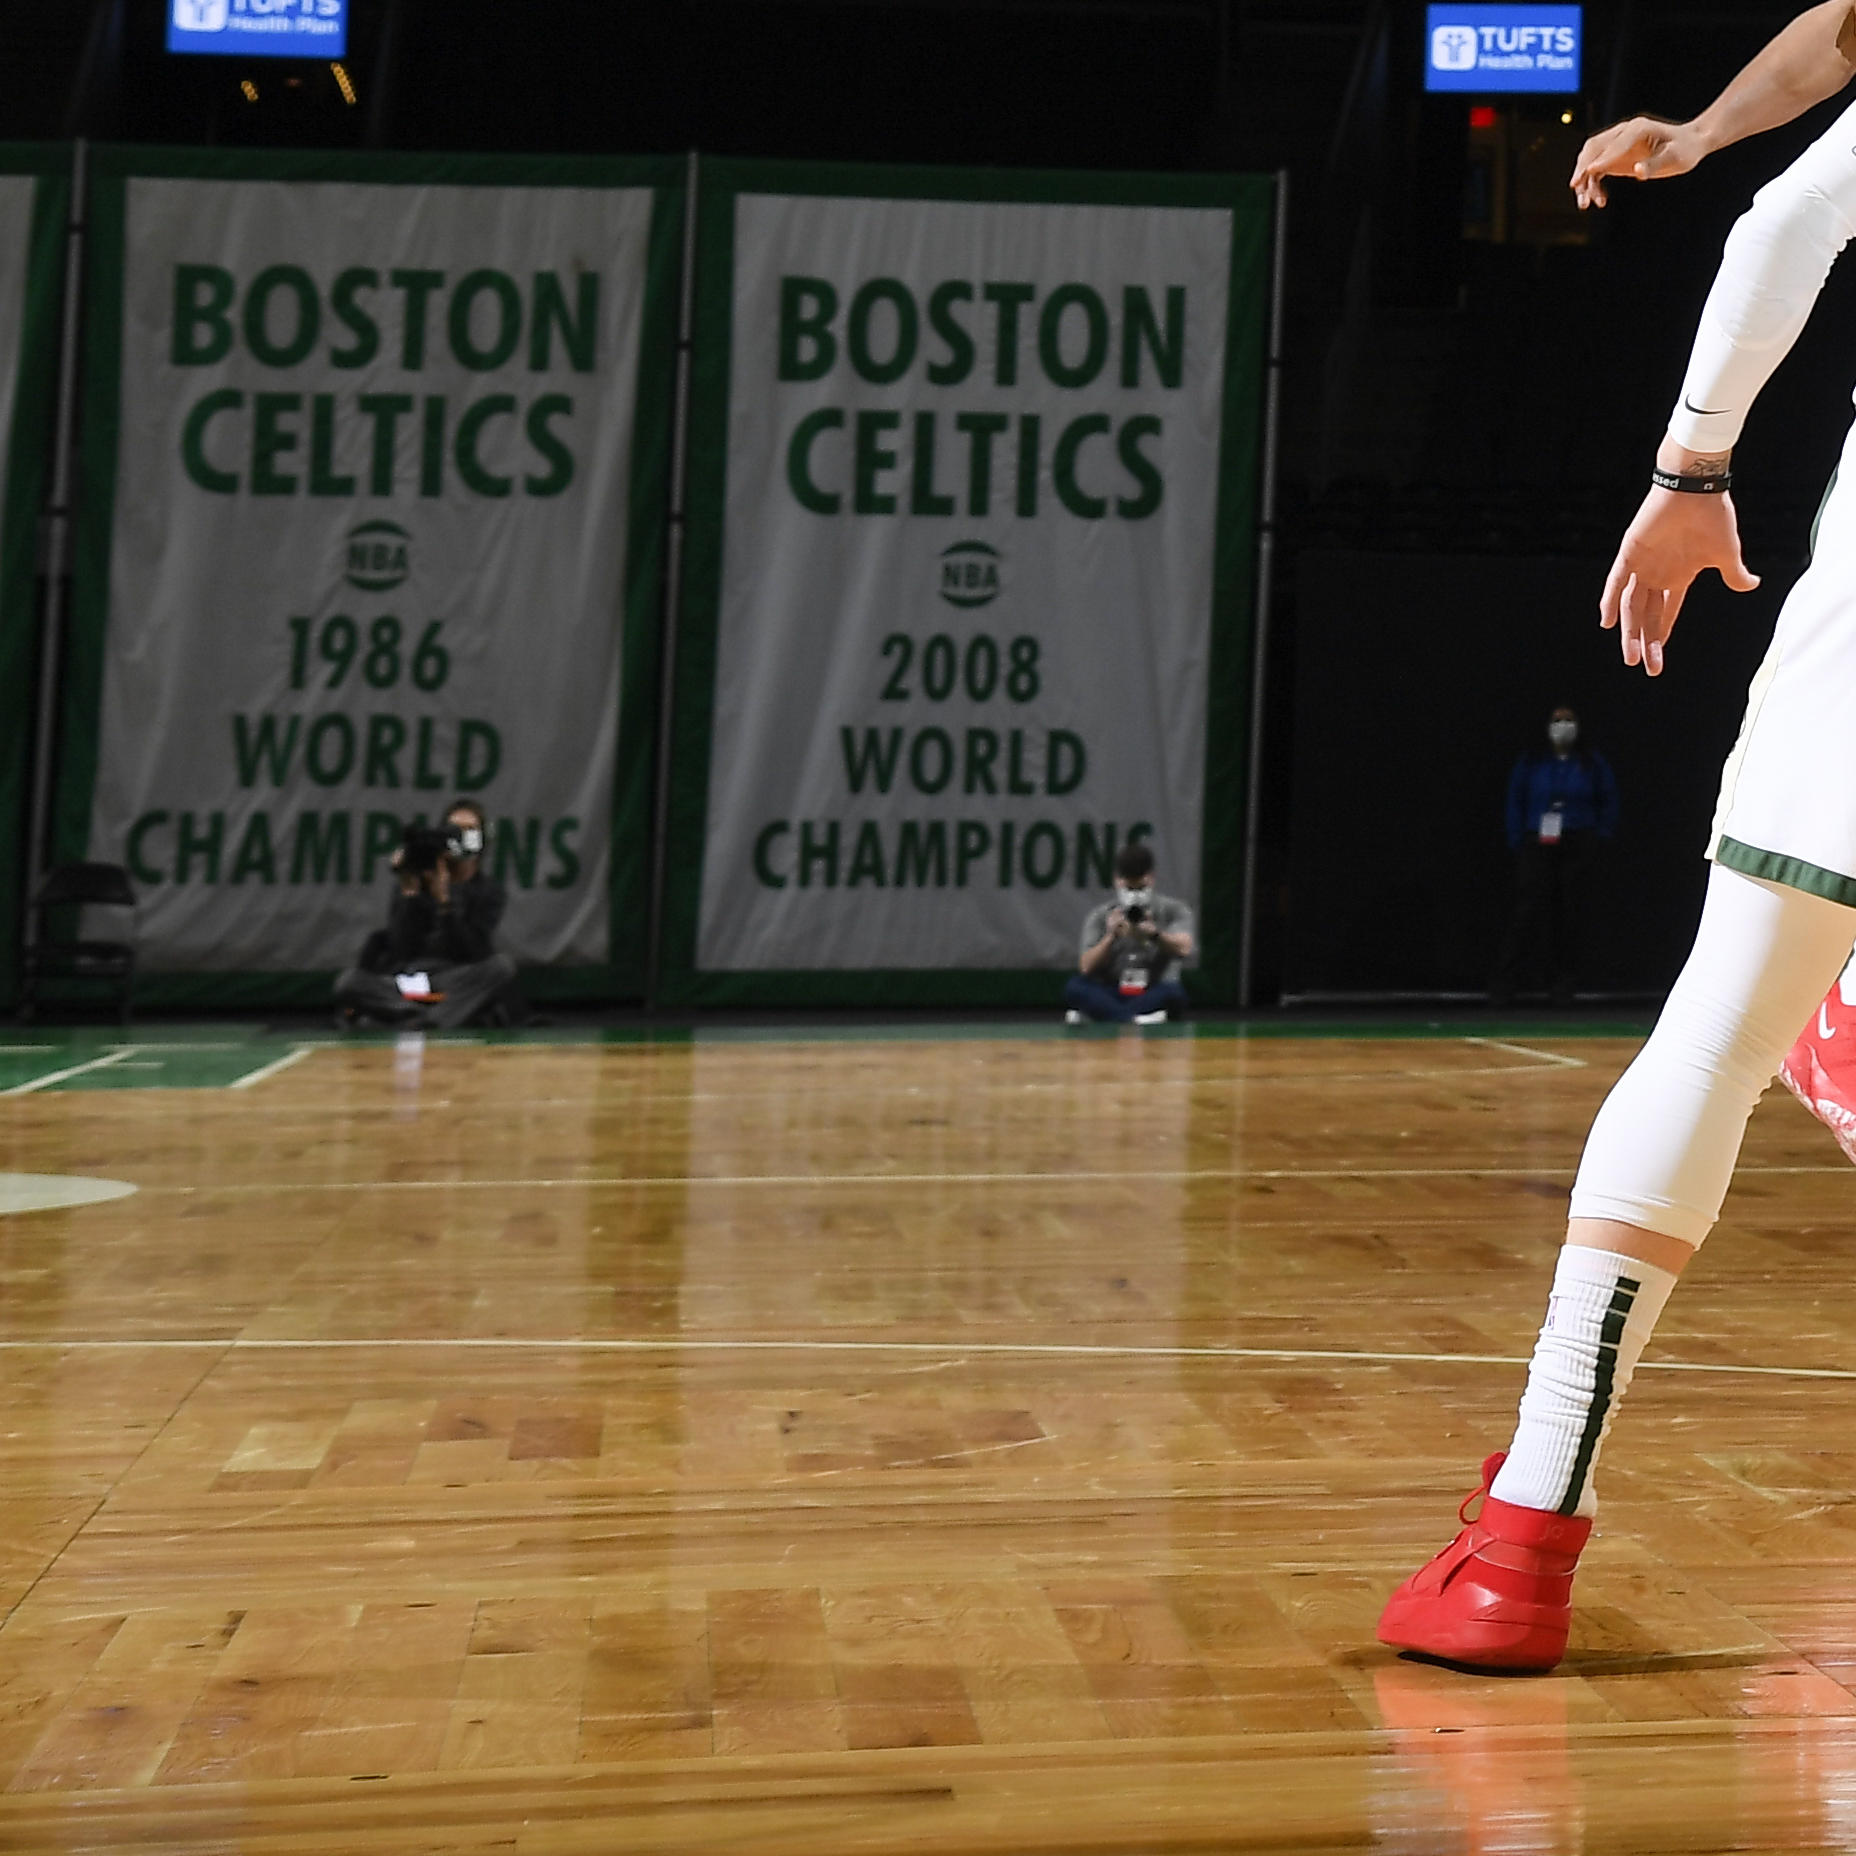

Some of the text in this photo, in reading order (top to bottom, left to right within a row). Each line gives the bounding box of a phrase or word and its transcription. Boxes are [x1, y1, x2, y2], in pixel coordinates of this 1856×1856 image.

[1478, 25, 1575, 53] TUFTS
[170, 263, 601, 373] BOSTON
[778, 276, 1186, 389] BOSTON
[182, 388, 577, 498] CELTICS
[786, 407, 1164, 521] CELTICS
[345, 544, 409, 572] NBA
[942, 560, 998, 590] NBA
[288, 615, 451, 692] 1986
[879, 633, 1042, 704] 2008
[232, 713, 501, 792] WORLD
[840, 724, 1088, 796] WORLD
[126, 809, 581, 890] CHAMPNS
